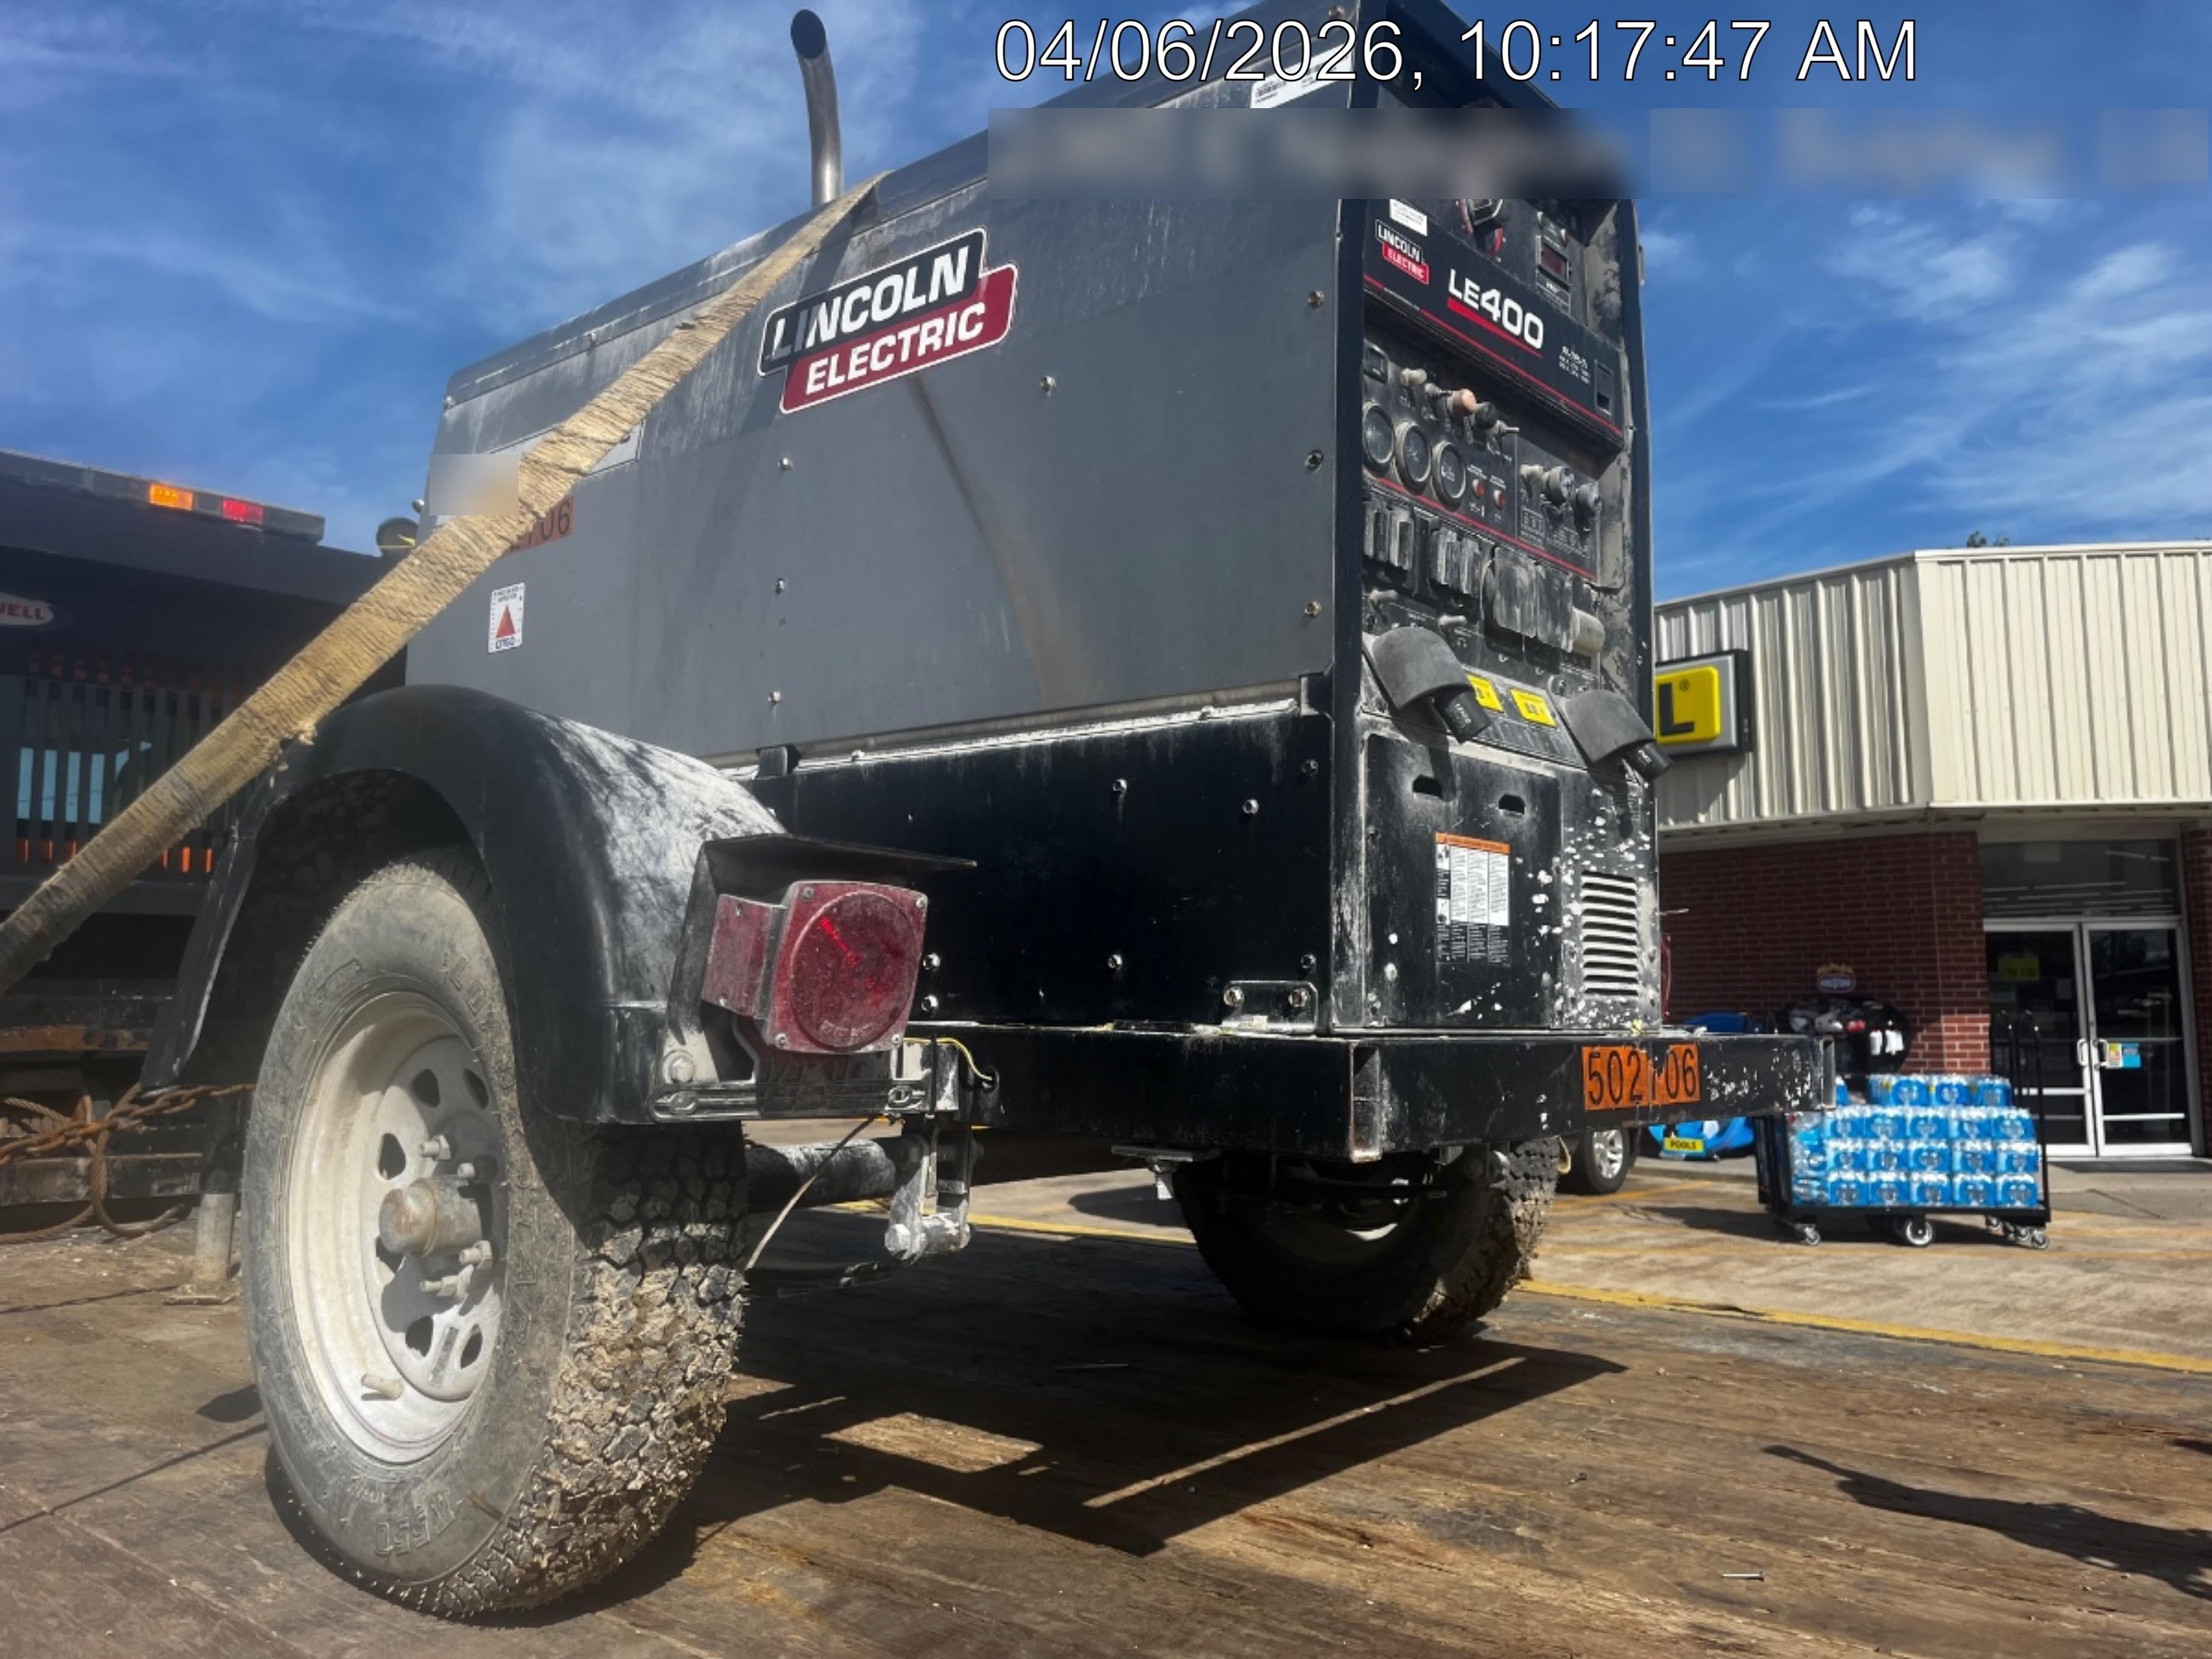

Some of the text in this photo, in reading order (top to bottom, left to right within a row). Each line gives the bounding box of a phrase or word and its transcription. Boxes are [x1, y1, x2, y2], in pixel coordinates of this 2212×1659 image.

[1378, 225, 1420, 262] LINCOLN
[772, 246, 969, 360] LINCOLN
[1448, 269, 1543, 349] LE400
[806, 302, 986, 395] ELECTRIC
